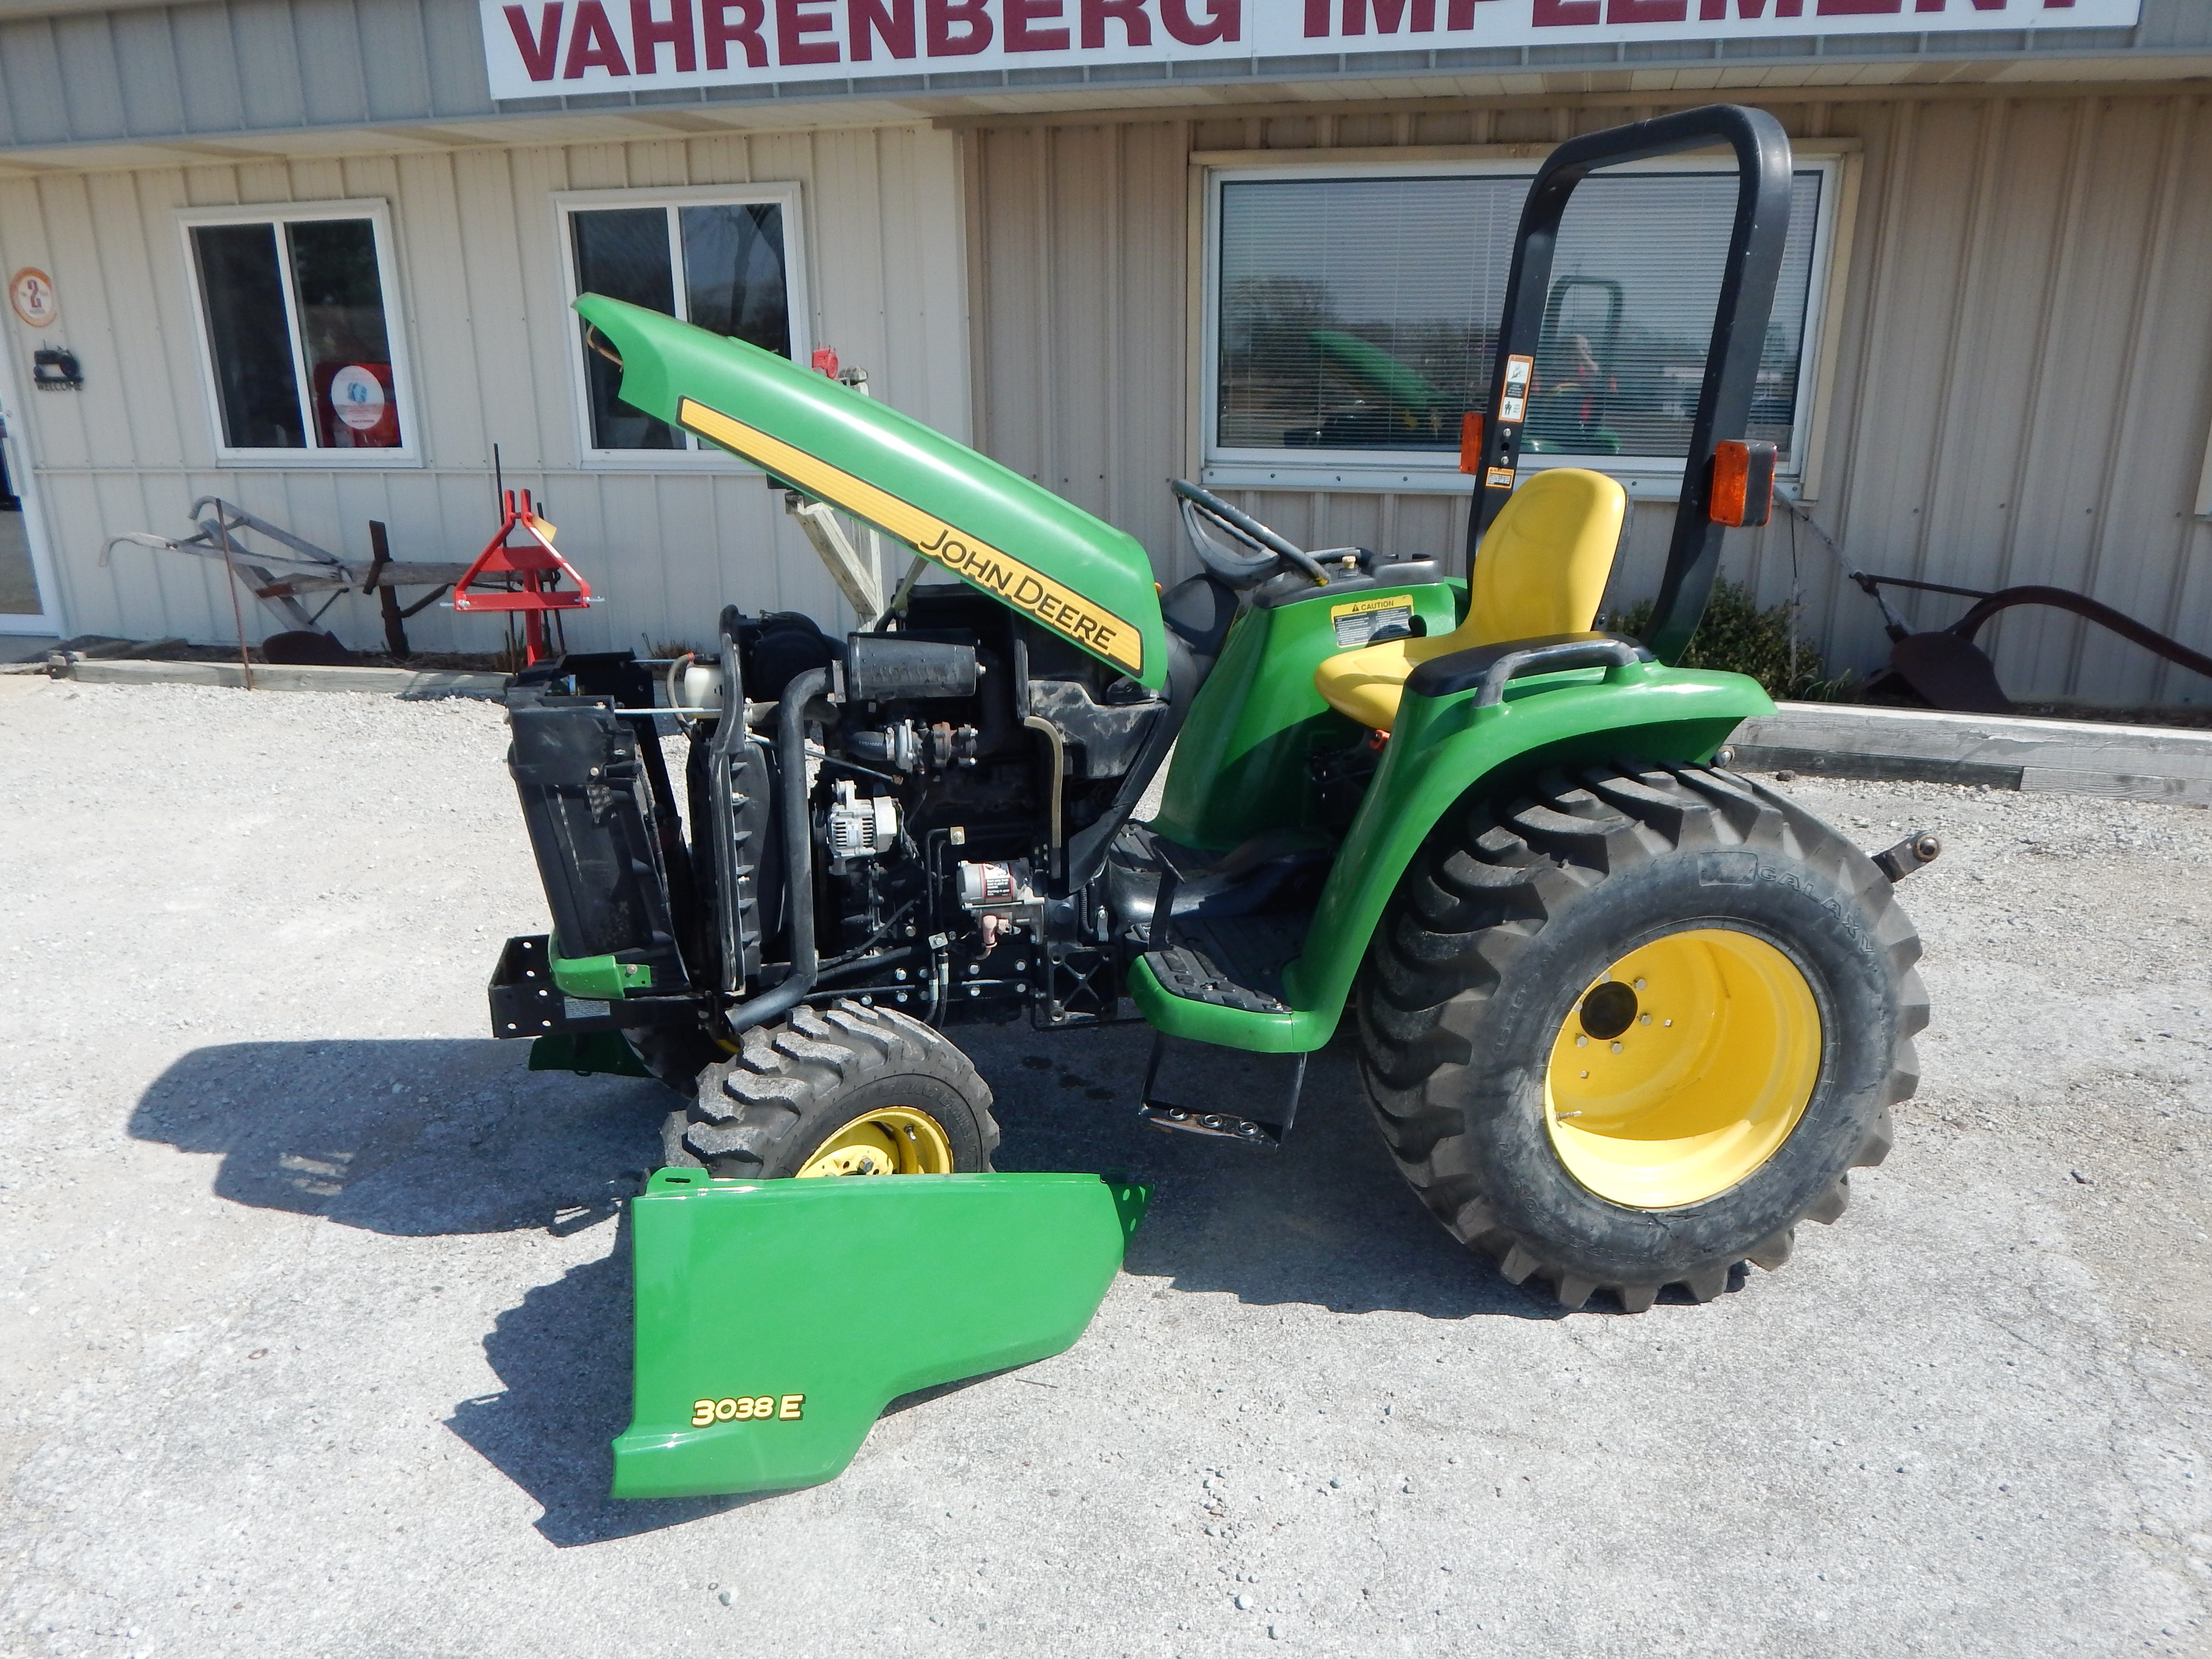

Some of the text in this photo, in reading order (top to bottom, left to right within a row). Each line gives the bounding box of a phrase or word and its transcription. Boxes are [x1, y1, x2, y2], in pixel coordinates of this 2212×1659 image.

[503, 0, 1240, 81] VAHRENBERG
[920, 529, 1117, 650] JOHN DEERE
[1361, 600, 1394, 611] CAUTION
[1760, 866, 1875, 957] GALAXY
[691, 1394, 806, 1428] 3038 E
